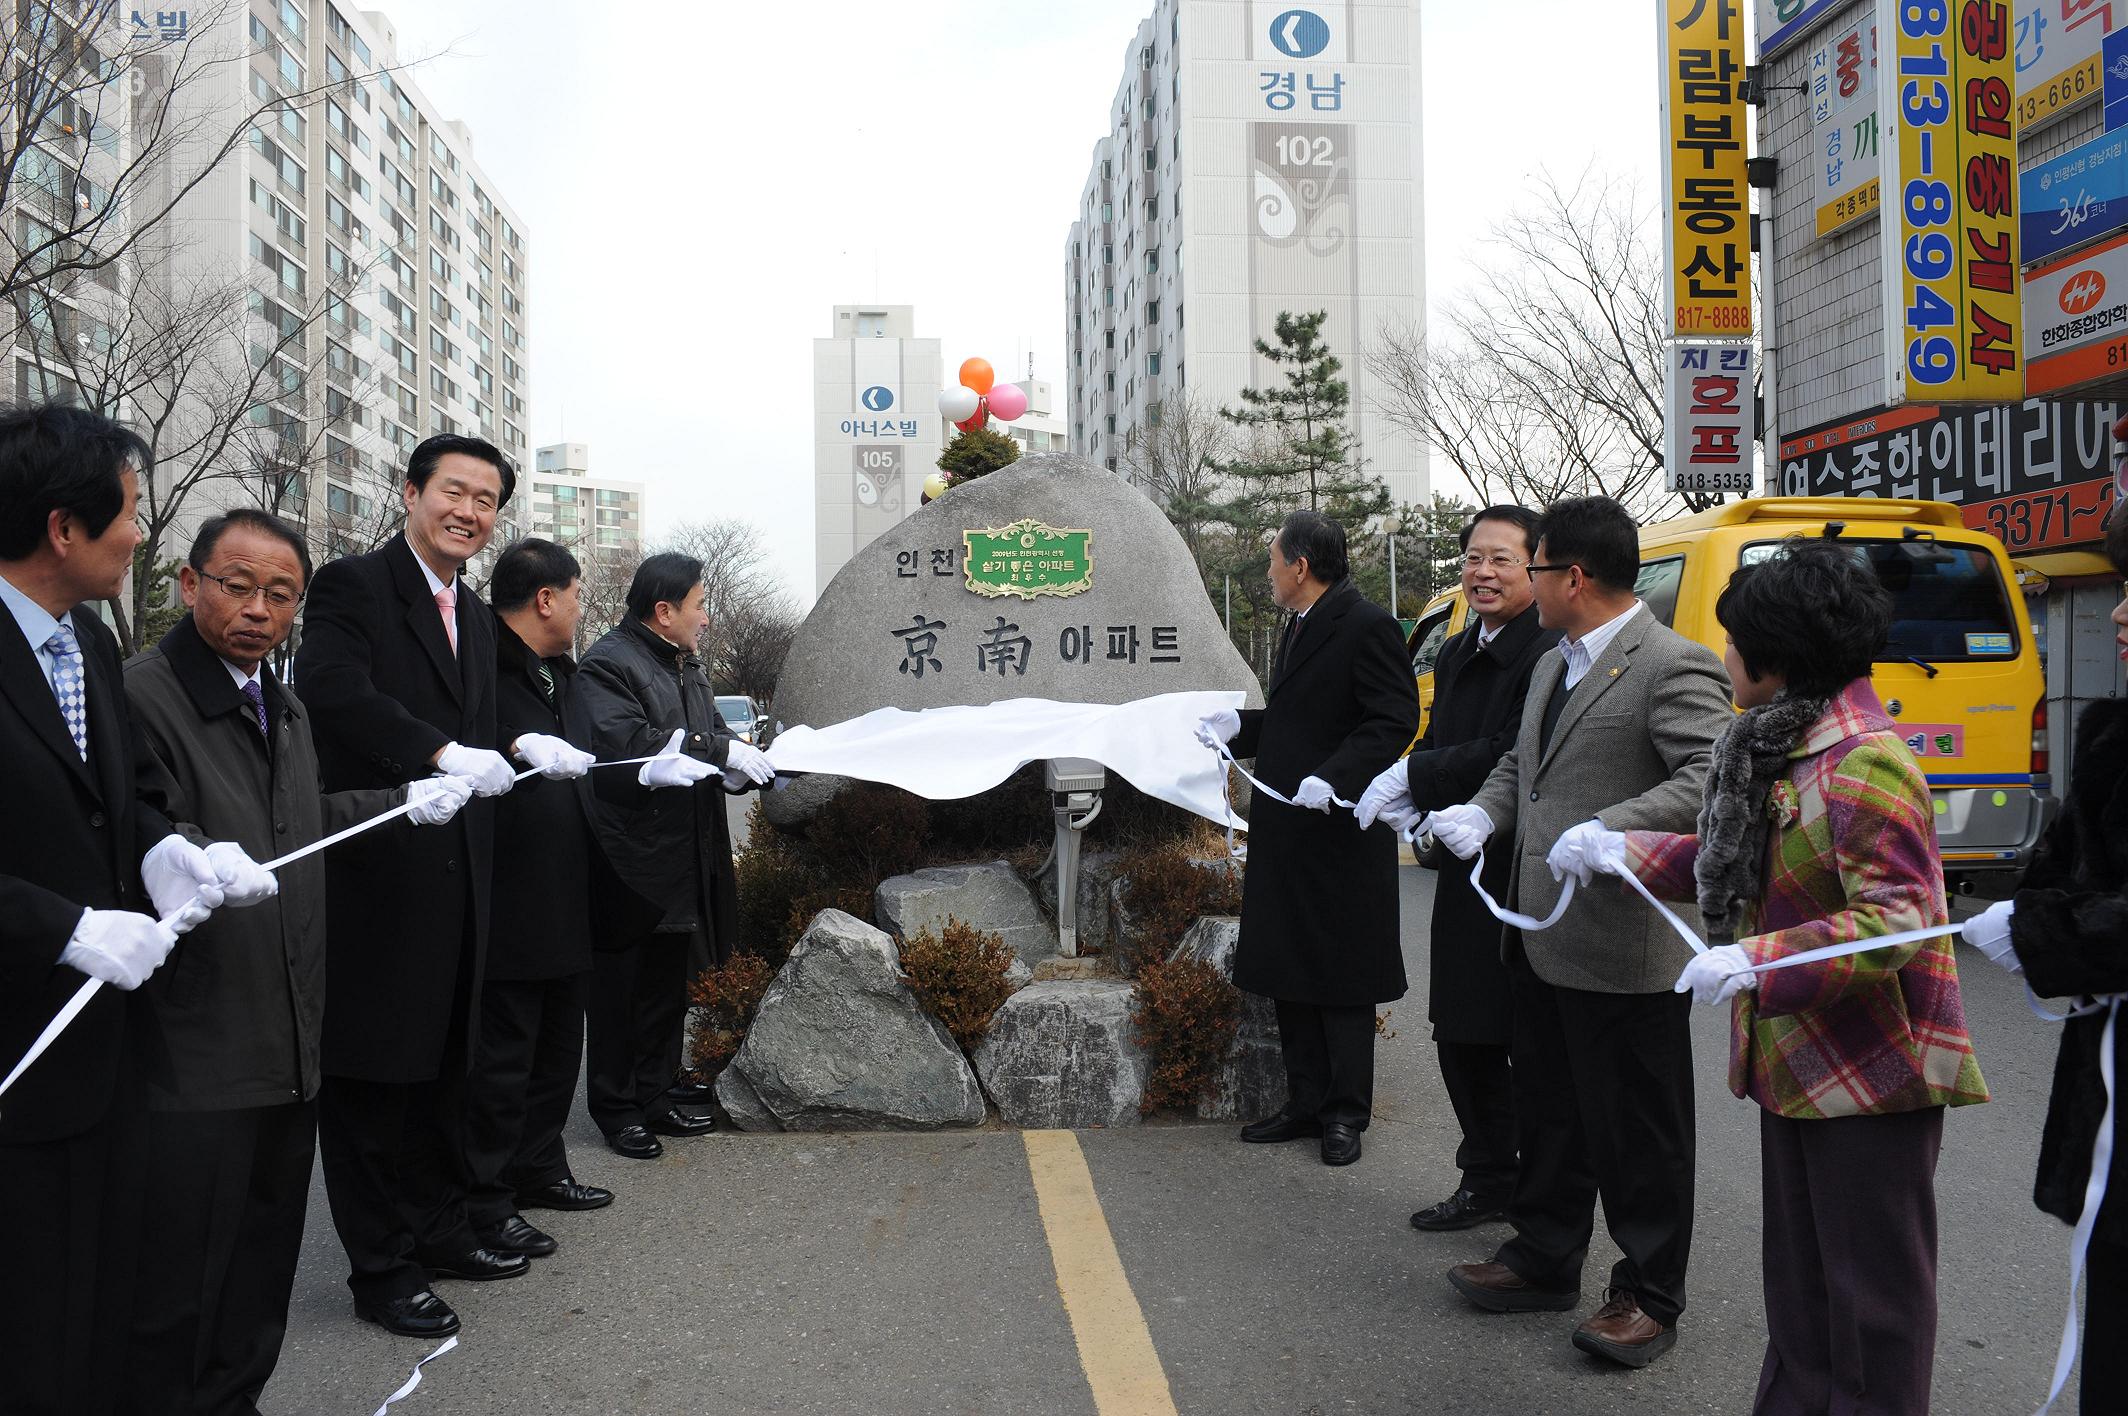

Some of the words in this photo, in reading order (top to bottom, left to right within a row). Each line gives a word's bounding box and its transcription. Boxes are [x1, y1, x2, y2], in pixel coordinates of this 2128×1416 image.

[1259, 72, 1346, 111] 경남
[1812, 49, 1829, 121] 자금성
[1275, 135, 1334, 166] 102
[1674, 0, 1743, 298] 가람부동산
[1825, 128, 1843, 187] 경남
[1900, 0, 1957, 386] 813-8949
[1960, 0, 2016, 376] 공인중개사
[2050, 188, 2097, 235] 365
[1677, 306, 1749, 329] 817-8888
[1680, 348, 1748, 371] 치킨
[840, 420, 917, 437] 아너스빌
[1689, 374, 1742, 464] 호프
[862, 451, 893, 468] 105
[1676, 472, 1752, 490] 818-5353
[896, 549, 954, 578] 인천
[982, 560, 1006, 573] 살기
[1038, 559, 1076, 572] 아파트
[1059, 625, 1181, 665] 아파트
